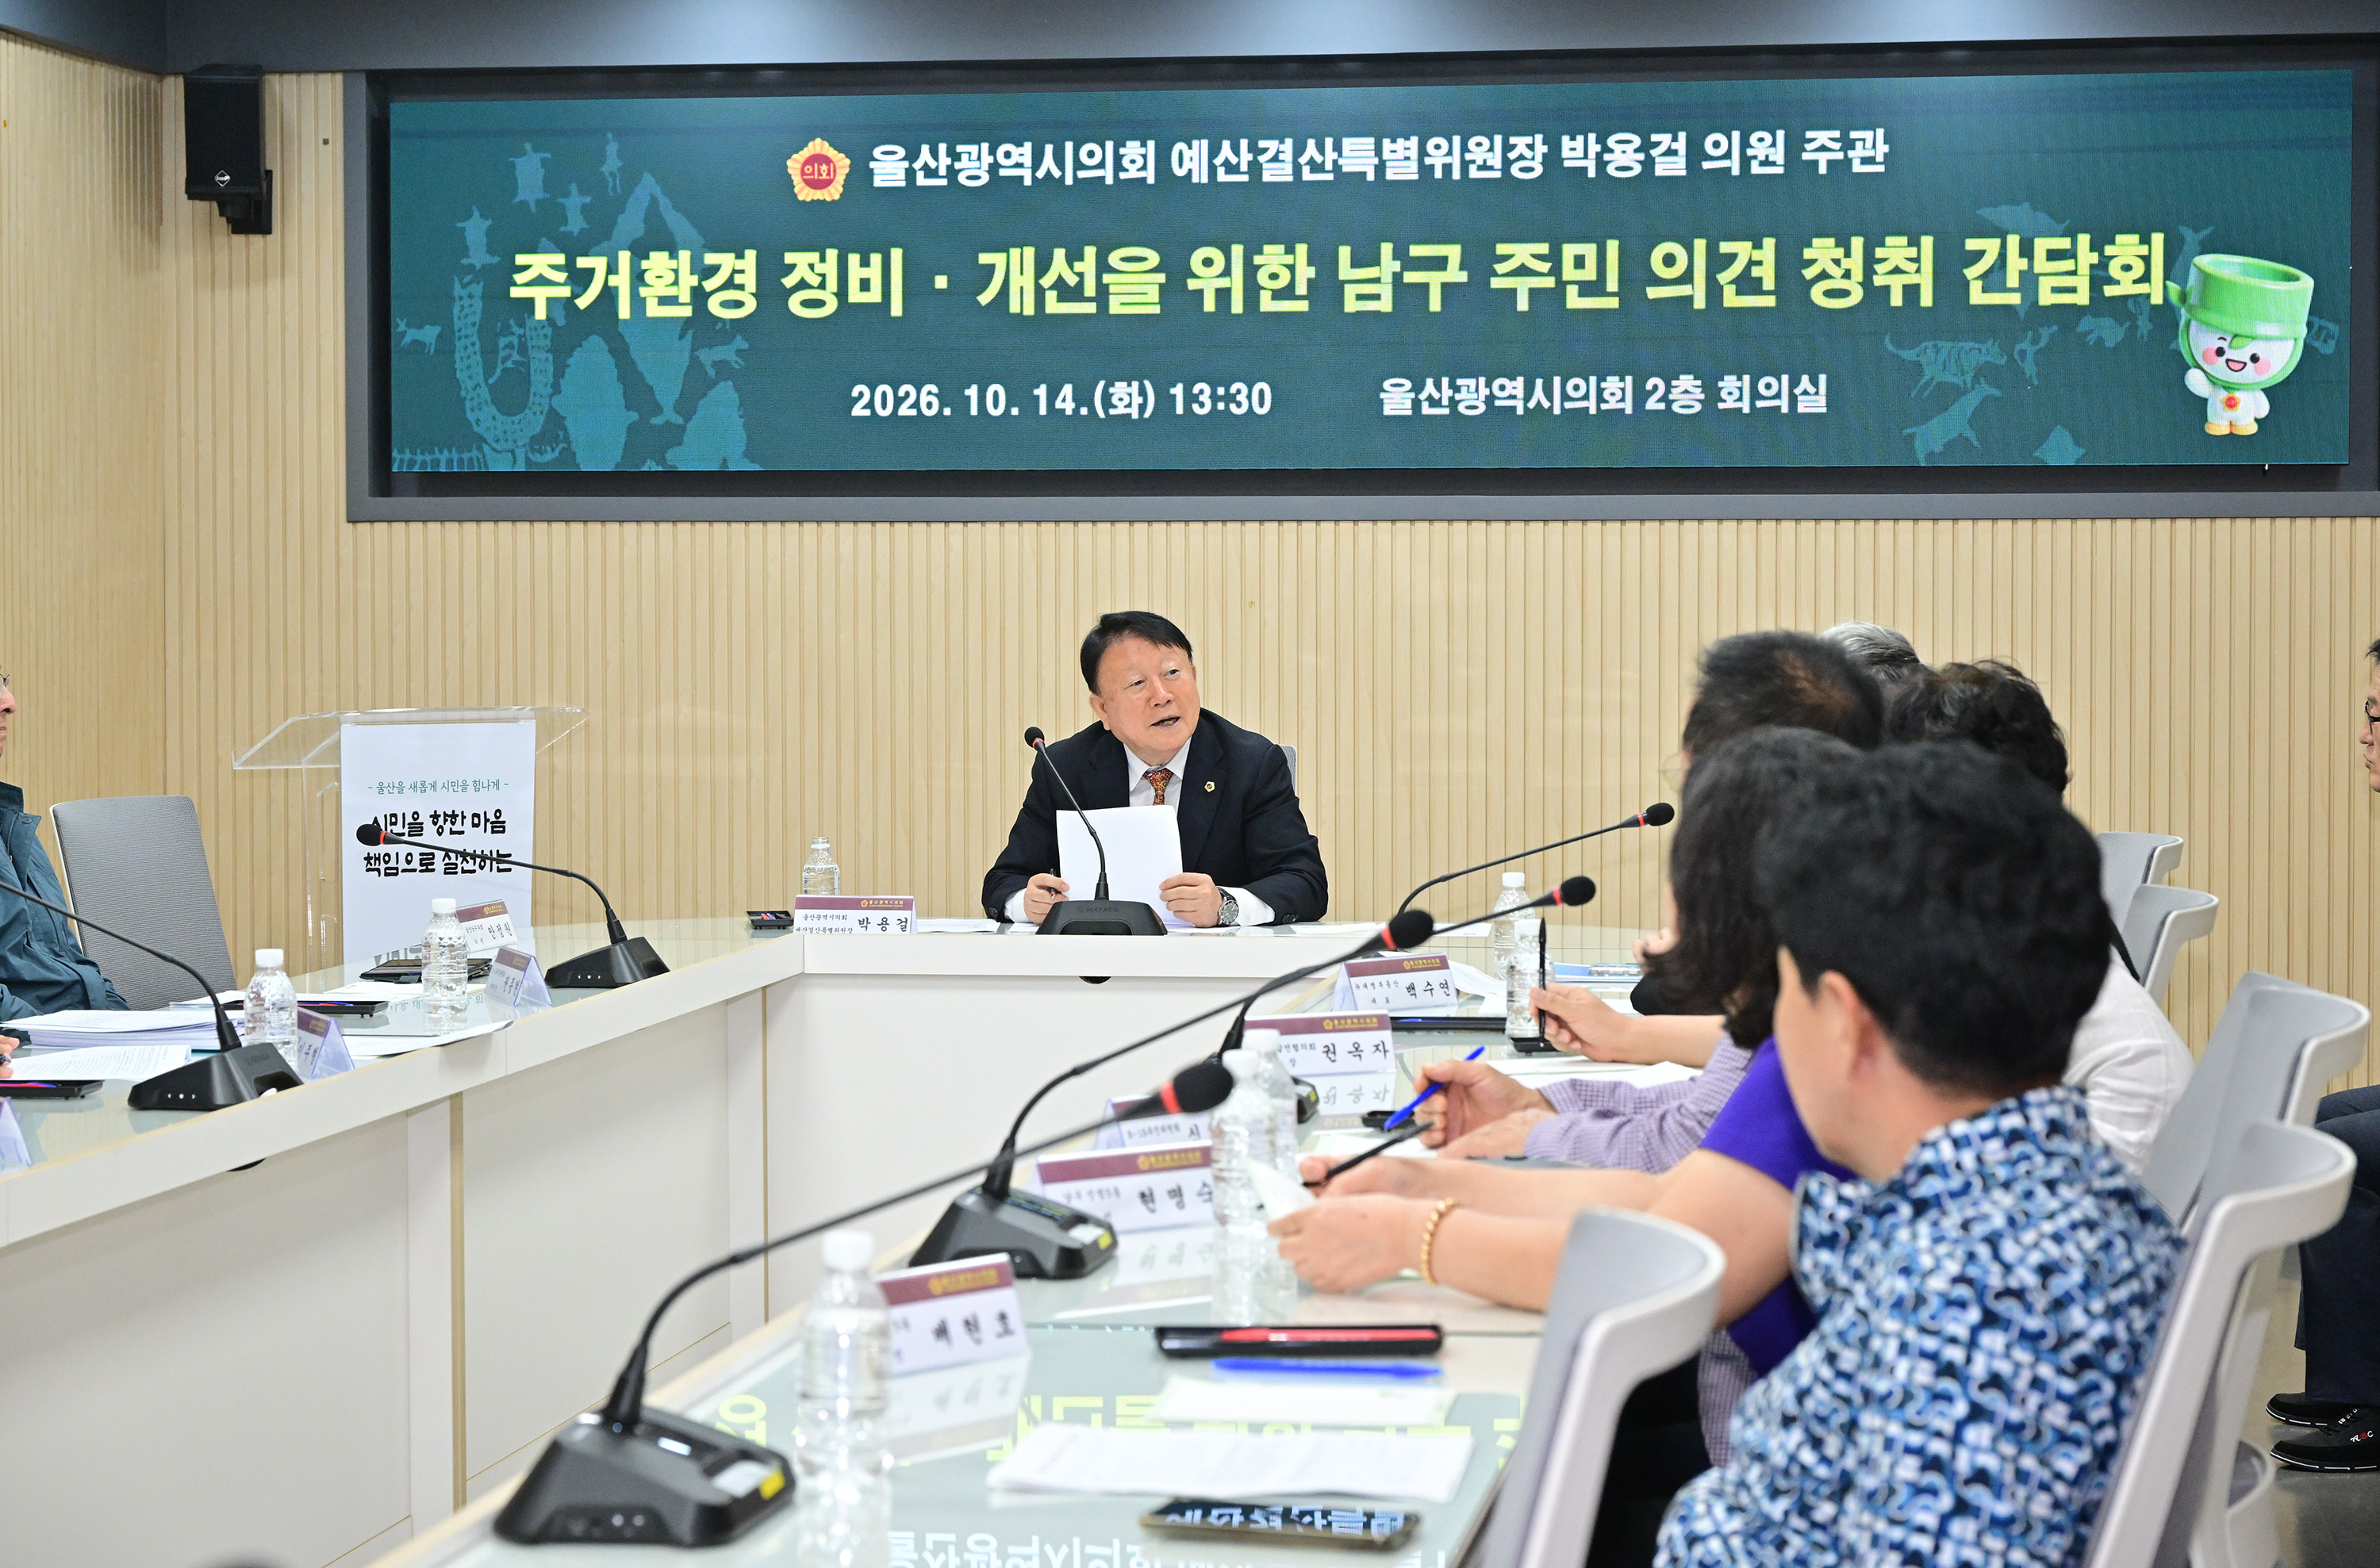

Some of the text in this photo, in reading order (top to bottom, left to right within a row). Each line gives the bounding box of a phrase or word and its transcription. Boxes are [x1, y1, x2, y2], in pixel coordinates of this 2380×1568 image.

[802, 162, 834, 180] 의회
[869, 128, 1890, 188] 울산광역시의회 예산결산특별위원장 박용걸 의원 주관
[509, 250, 758, 321] 주거환경
[781, 248, 904, 320] 정비
[977, 246, 1167, 316] 개선을
[1187, 243, 1316, 315] 위한
[1338, 243, 1468, 313] 남구
[1490, 240, 1620, 312] 주민
[1645, 238, 1777, 310] 의견
[1802, 236, 1934, 309] 청취
[1963, 232, 2165, 306] 간담회
[851, 374, 1828, 420] 2026. 10. 14.(화) 13:30 울산광역시의회 2층 회의실
[376, 781, 405, 794] 울산을
[409, 780, 437, 793] 새롭게
[440, 780, 469, 792] 시민을
[472, 779, 500, 792] 힘나게
[371, 808, 506, 838] 시민을 향한 마음
[363, 849, 512, 877] 책임으로 실천하는
